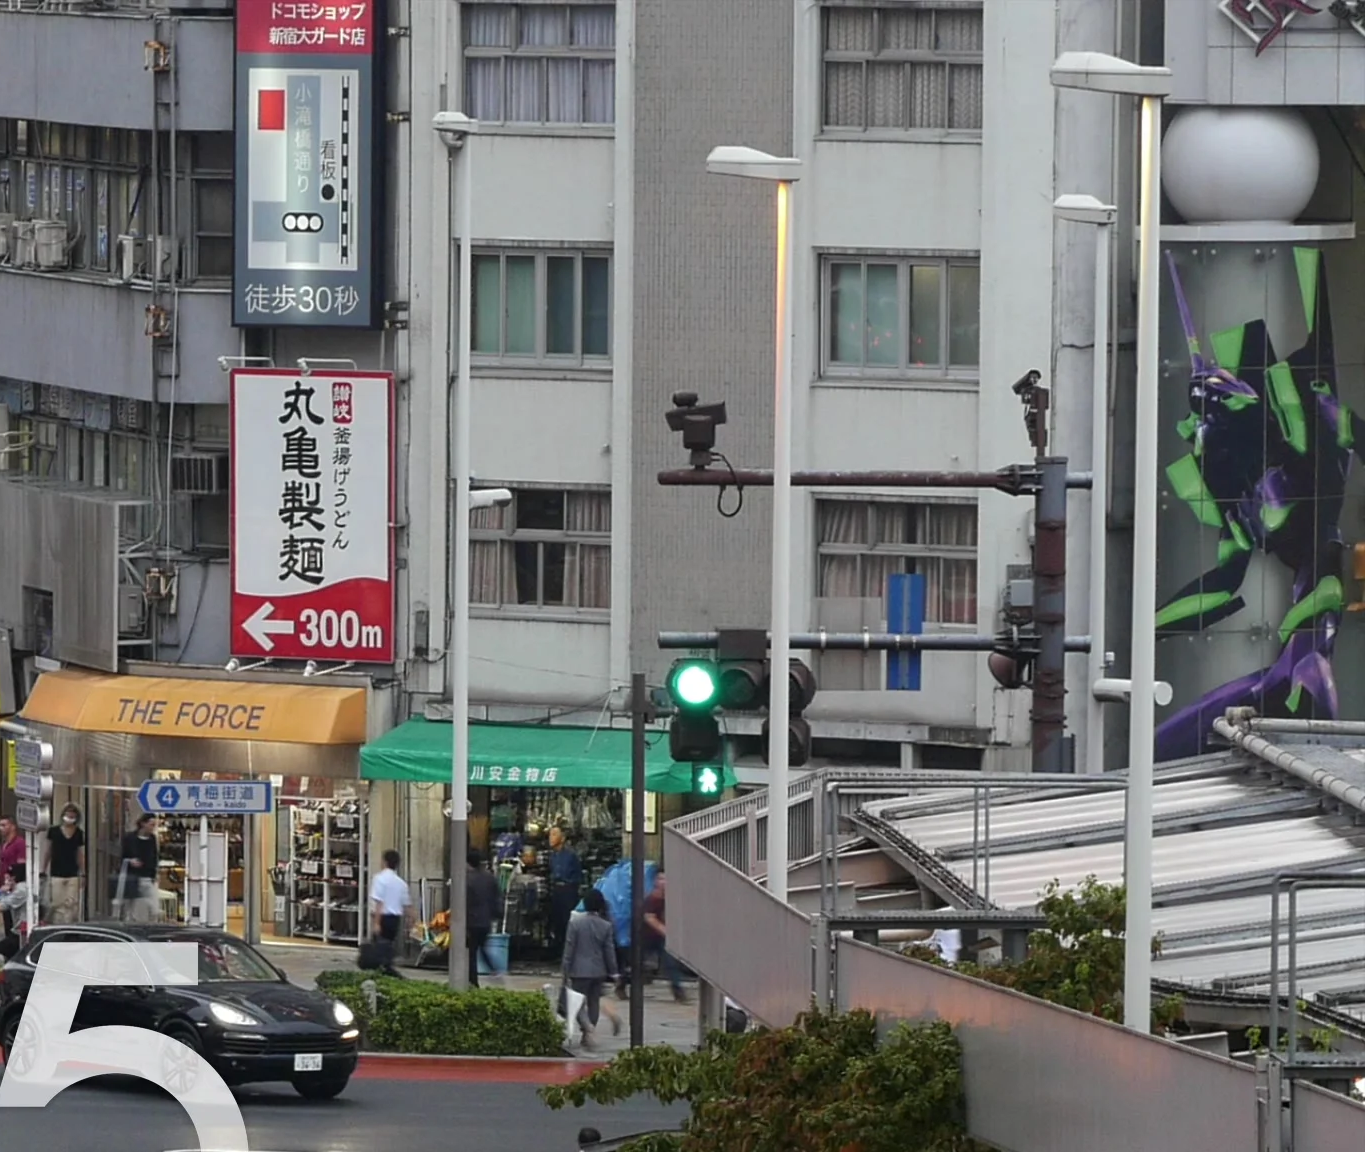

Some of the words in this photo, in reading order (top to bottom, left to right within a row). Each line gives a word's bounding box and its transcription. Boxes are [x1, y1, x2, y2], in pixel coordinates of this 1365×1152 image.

[270, 3, 365, 20] ドコモショップ
[269, 26, 365, 46] 新宿大ガード店
[293, 82, 312, 193] 小滝橋通り
[320, 139, 336, 181] 看板
[245, 284, 359, 315] 徒歩30秒
[299, 607, 382, 649] 300m
[117, 697, 167, 726] THE
[174, 701, 266, 732] FORCE
[469, 765, 559, 783] 川安金物店
[161, 790, 174, 807] 4
[187, 785, 254, 801] 青梅街道
